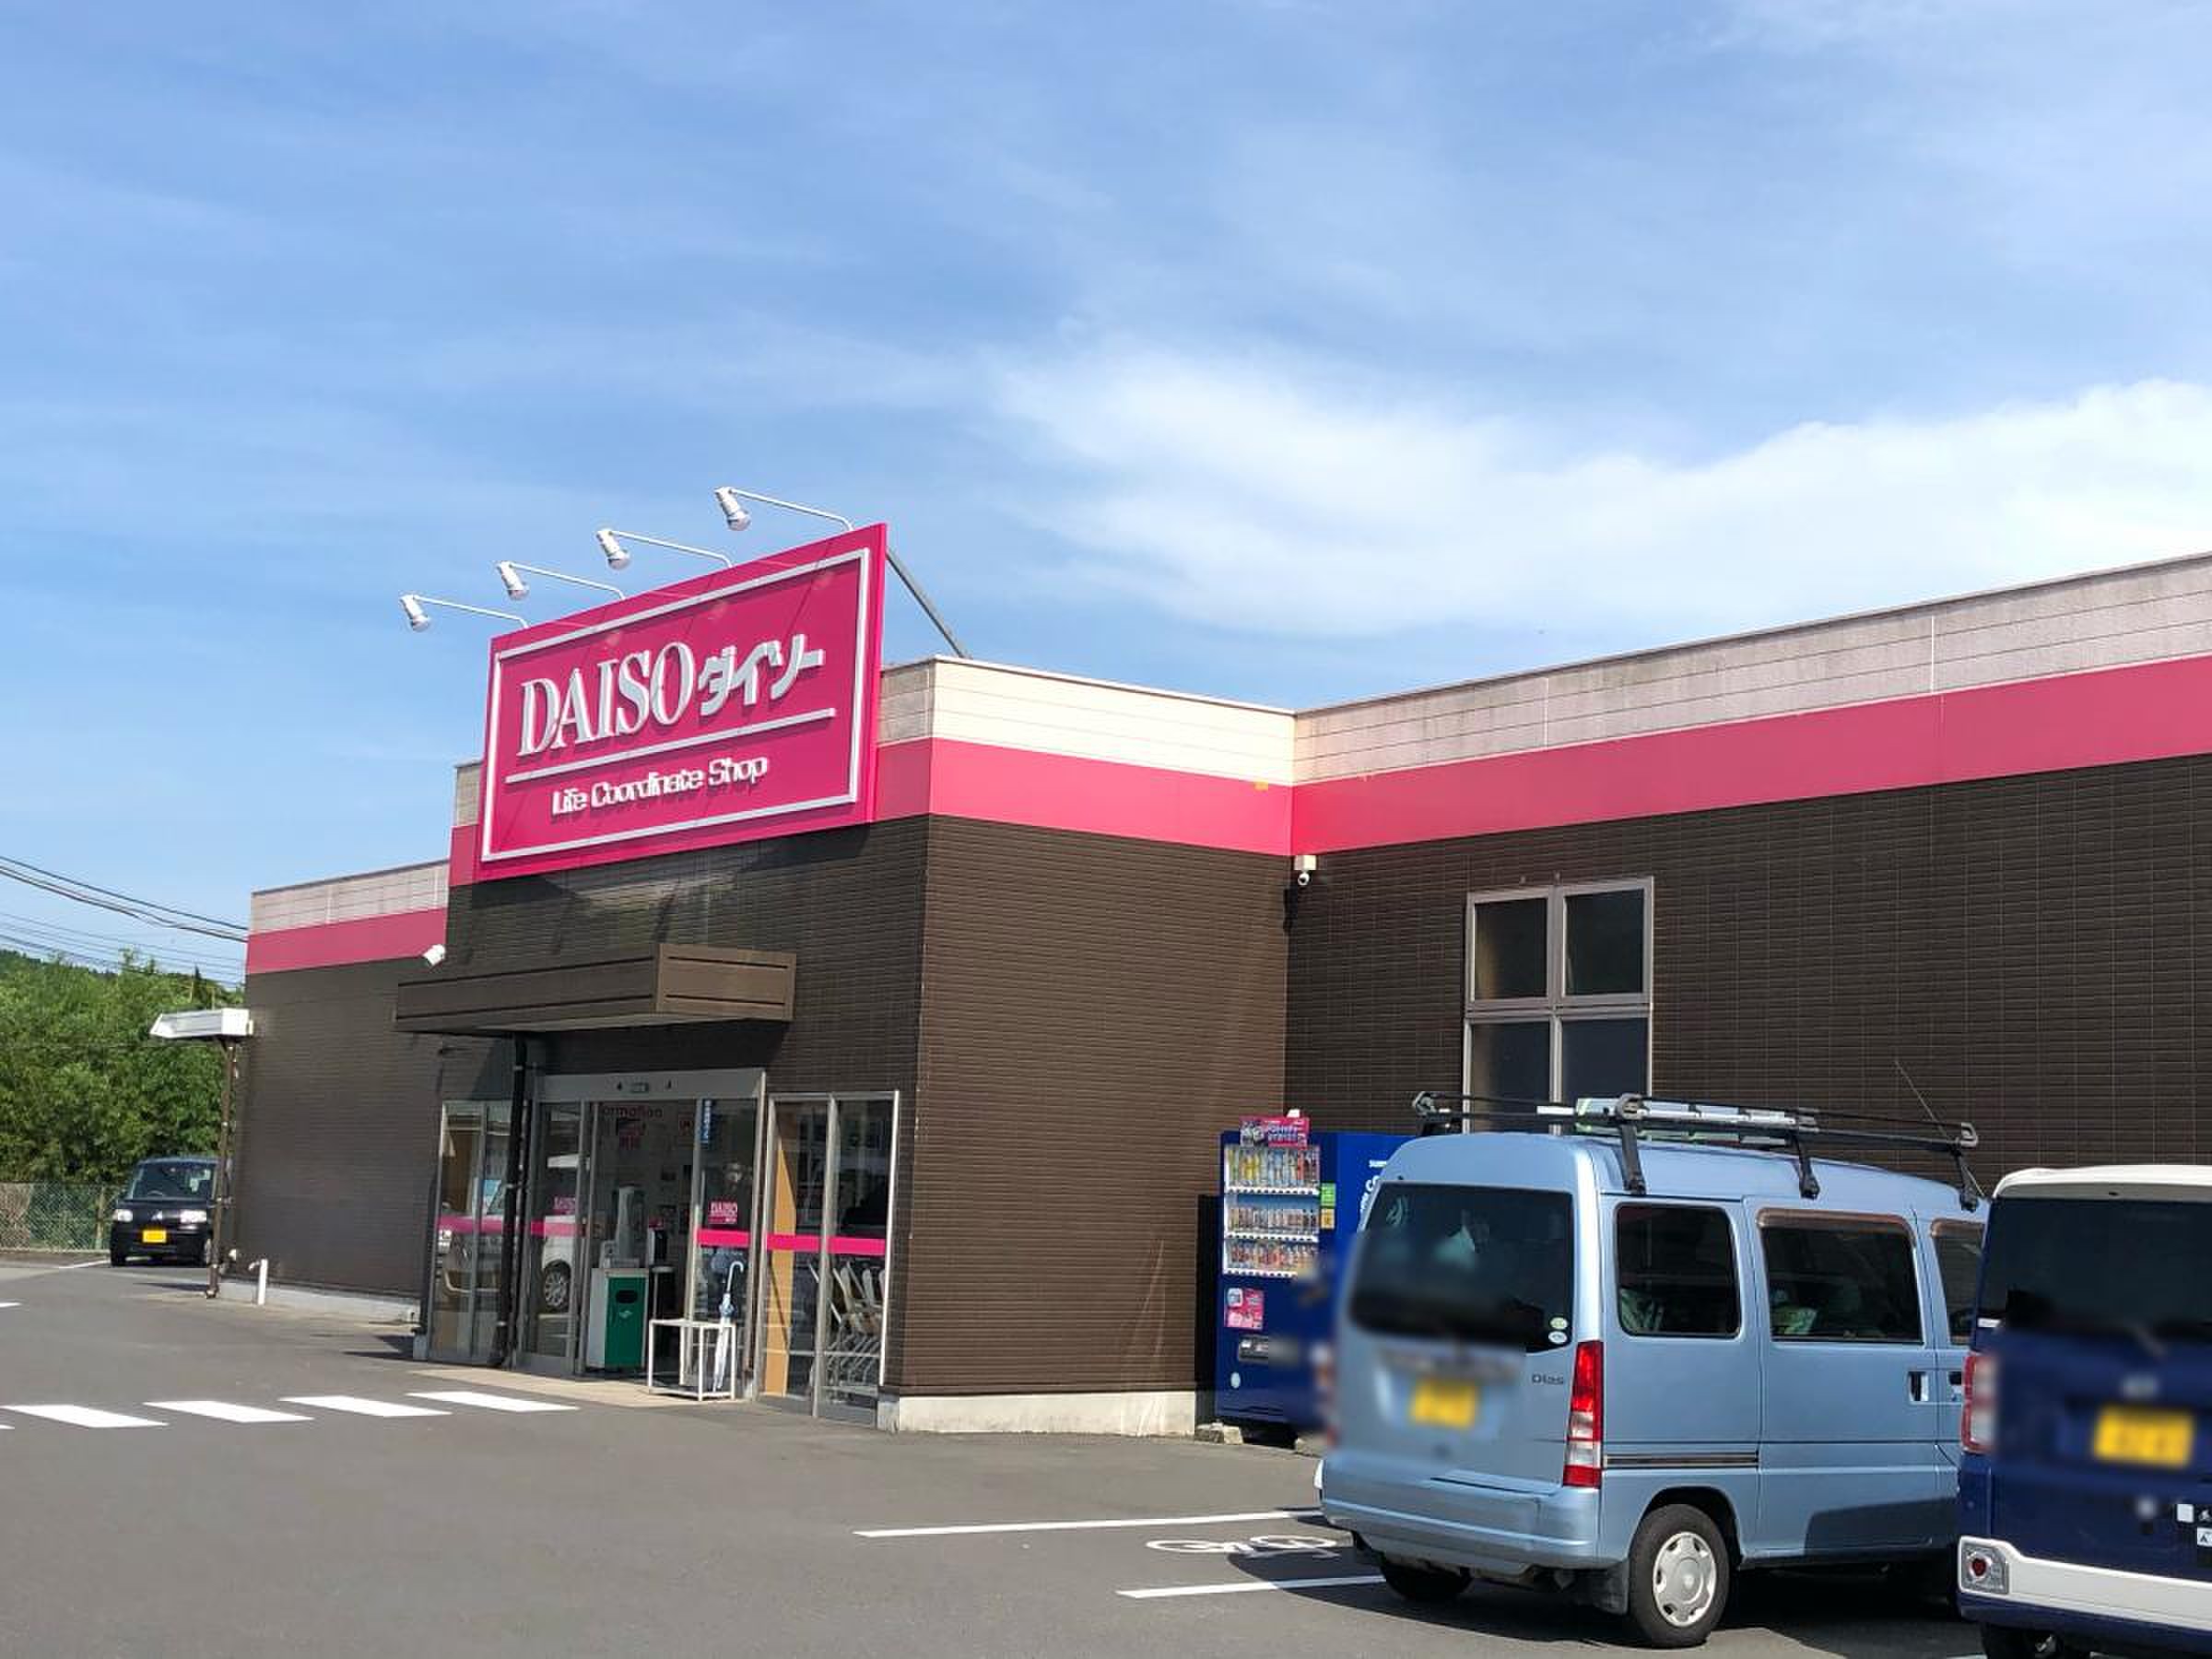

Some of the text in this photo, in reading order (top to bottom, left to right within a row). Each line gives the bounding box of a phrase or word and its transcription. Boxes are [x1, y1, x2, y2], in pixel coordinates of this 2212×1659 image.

[517, 642, 696, 756] DAISO
[552, 756, 768, 815] Life Coordinate Shop
